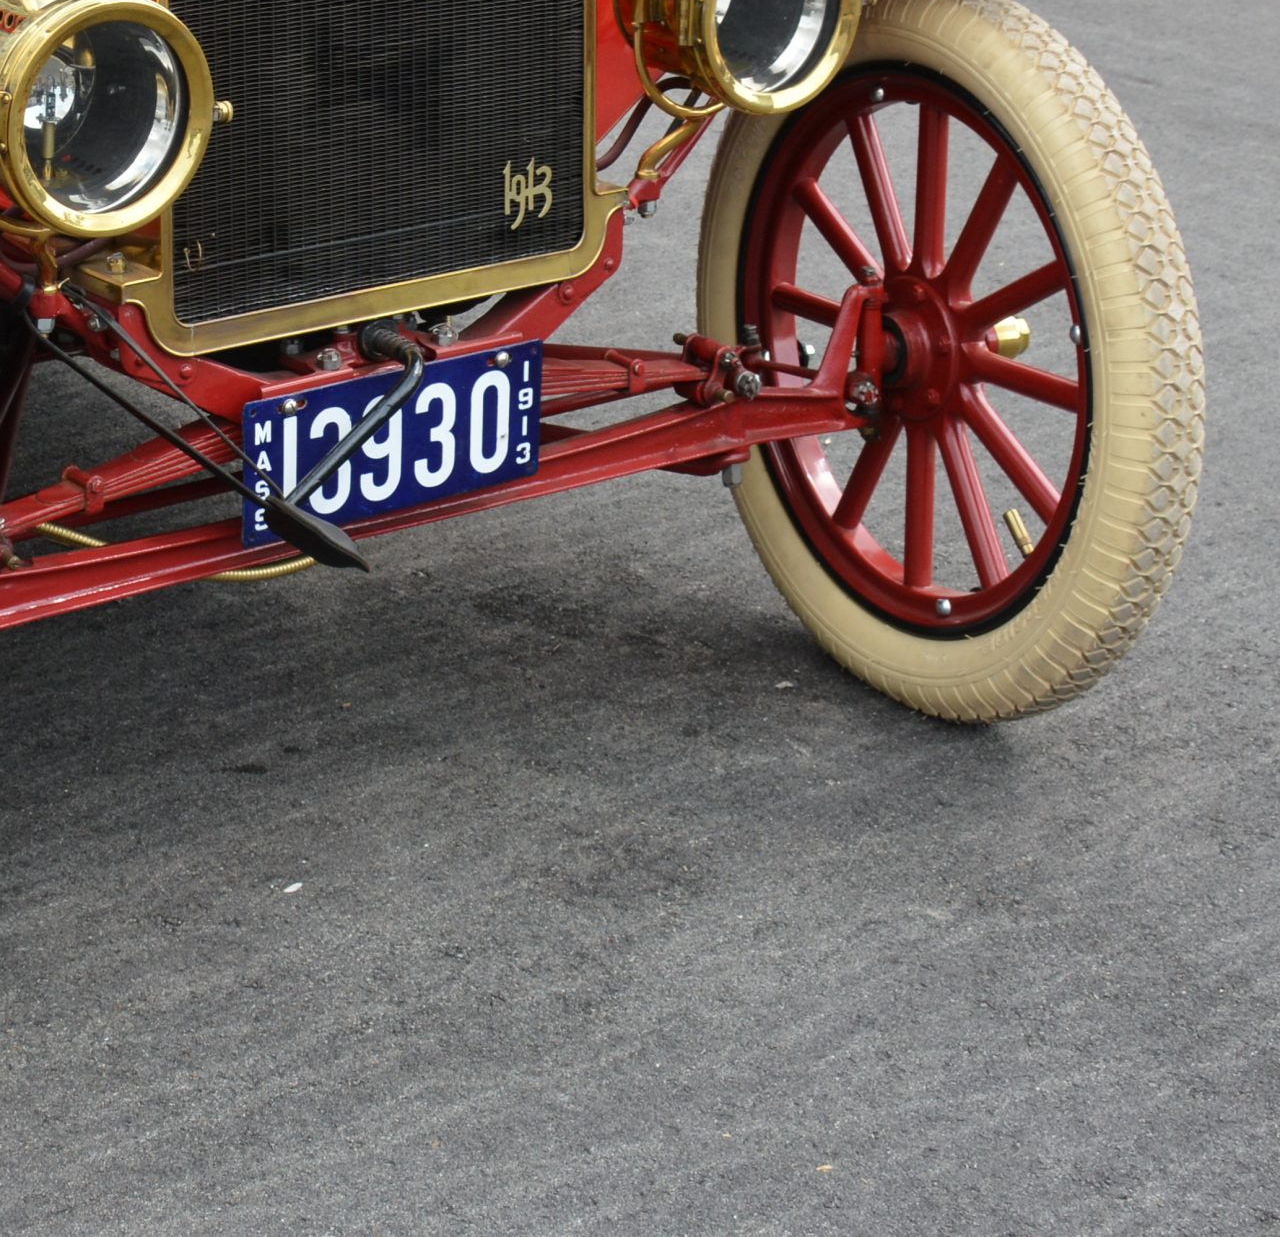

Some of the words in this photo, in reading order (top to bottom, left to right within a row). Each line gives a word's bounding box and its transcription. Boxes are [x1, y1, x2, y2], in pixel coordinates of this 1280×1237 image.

[502, 156, 553, 230] 1913
[282, 369, 512, 515] 13930
[515, 360, 534, 465] 1913
